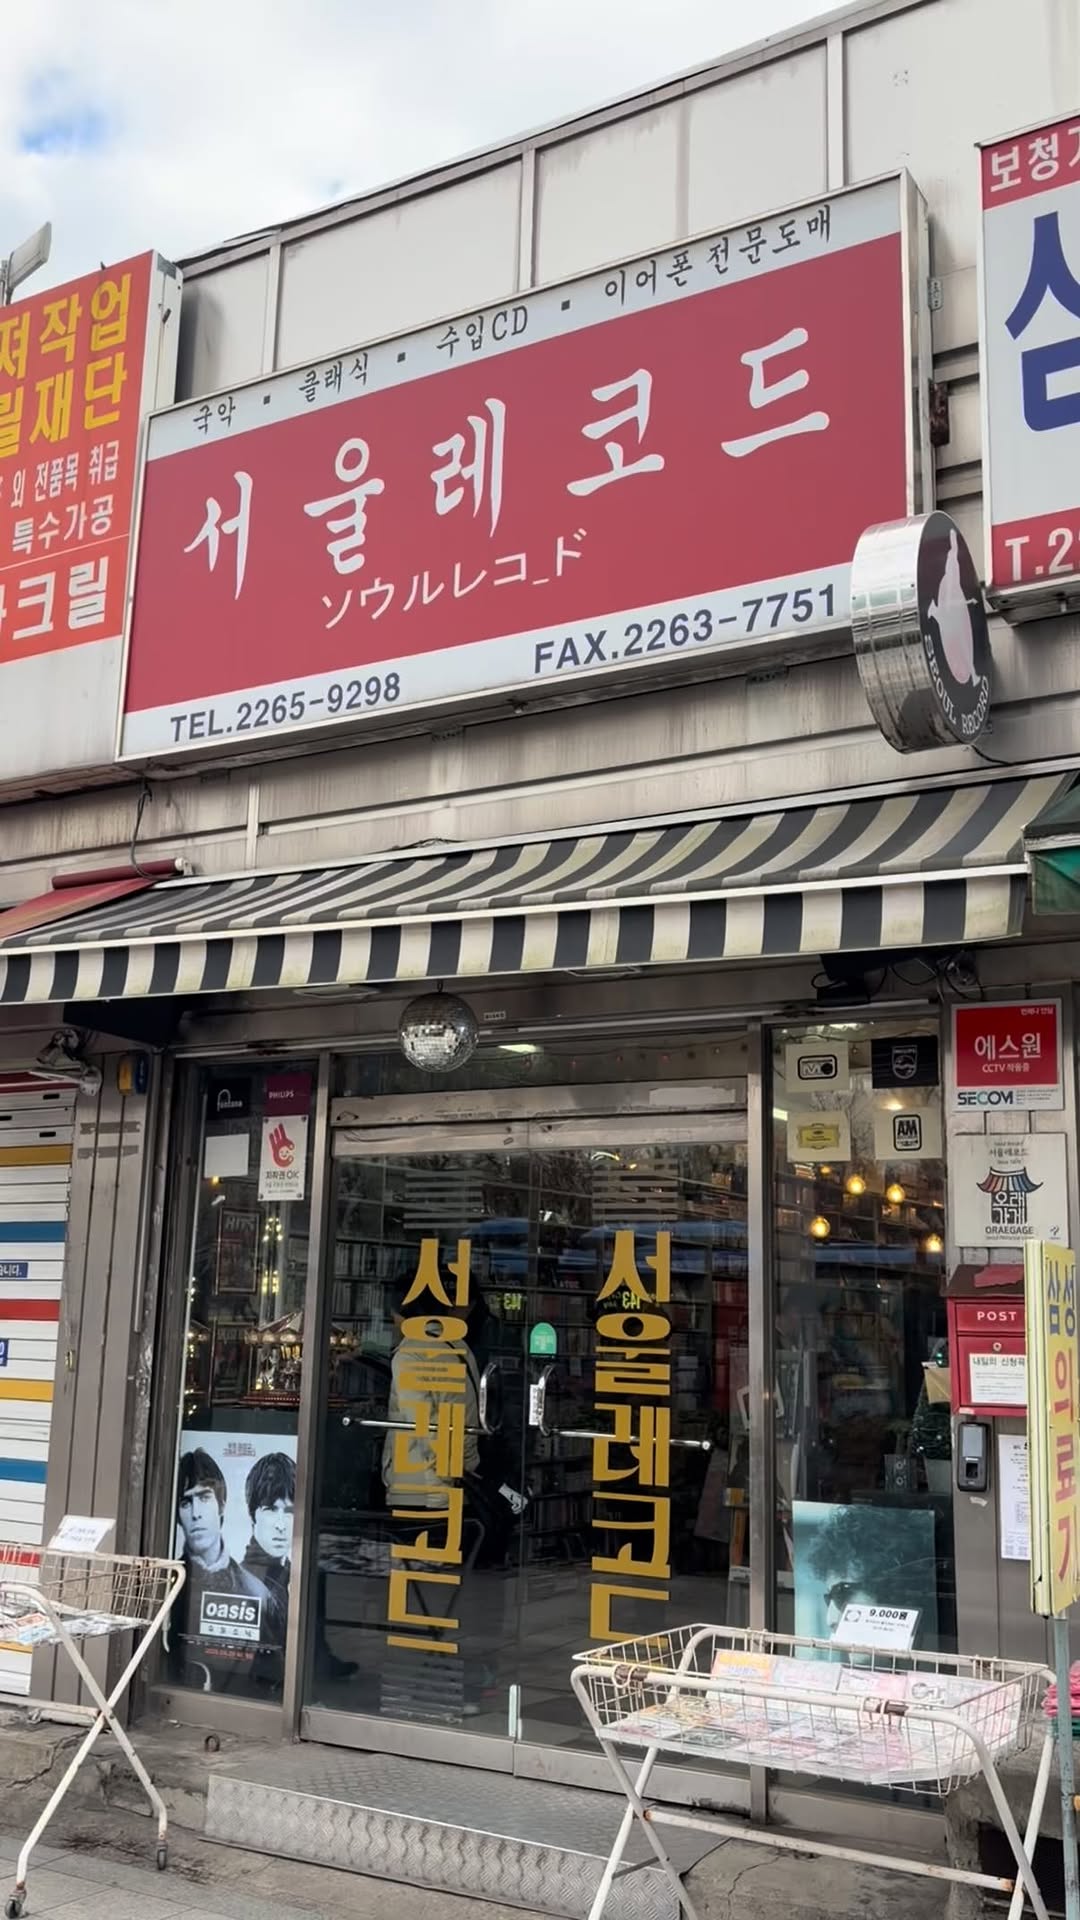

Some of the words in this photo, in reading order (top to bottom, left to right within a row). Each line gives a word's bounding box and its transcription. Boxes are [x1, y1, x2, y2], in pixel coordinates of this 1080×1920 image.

[193, 395, 236, 434] 국악
[299, 352, 369, 402] 클래식
[437, 305, 528, 358] 수입CD
[35, 452, 79, 502] 전품목
[88, 440, 119, 485] 취급
[184, 328, 829, 600] 서울레코드
[13, 494, 114, 554] 특수가공
[1005, 524, 1080, 581] T.2
[534, 584, 836, 674] FAX.2263-7751
[170, 672, 401, 742] TEL.2265-9298
[924, 634, 957, 726] SEOUL
[961, 675, 990, 736] RECORD
[974, 1032, 1041, 1060] 에스원
[982, 1063, 1005, 1073] CCTV
[268, 1090, 294, 1099] PHILIPS
[957, 1090, 1013, 1105] SECOM
[985, 1226, 1034, 1234] ORAEGAGE
[977, 1311, 1017, 1321] POST
[1048, 1260, 1076, 1337] 삼성
[386, 1237, 471, 1654] 서울레코드
[589, 1230, 671, 1672] 서울레코드
[206, 1601, 256, 1621] oasis
